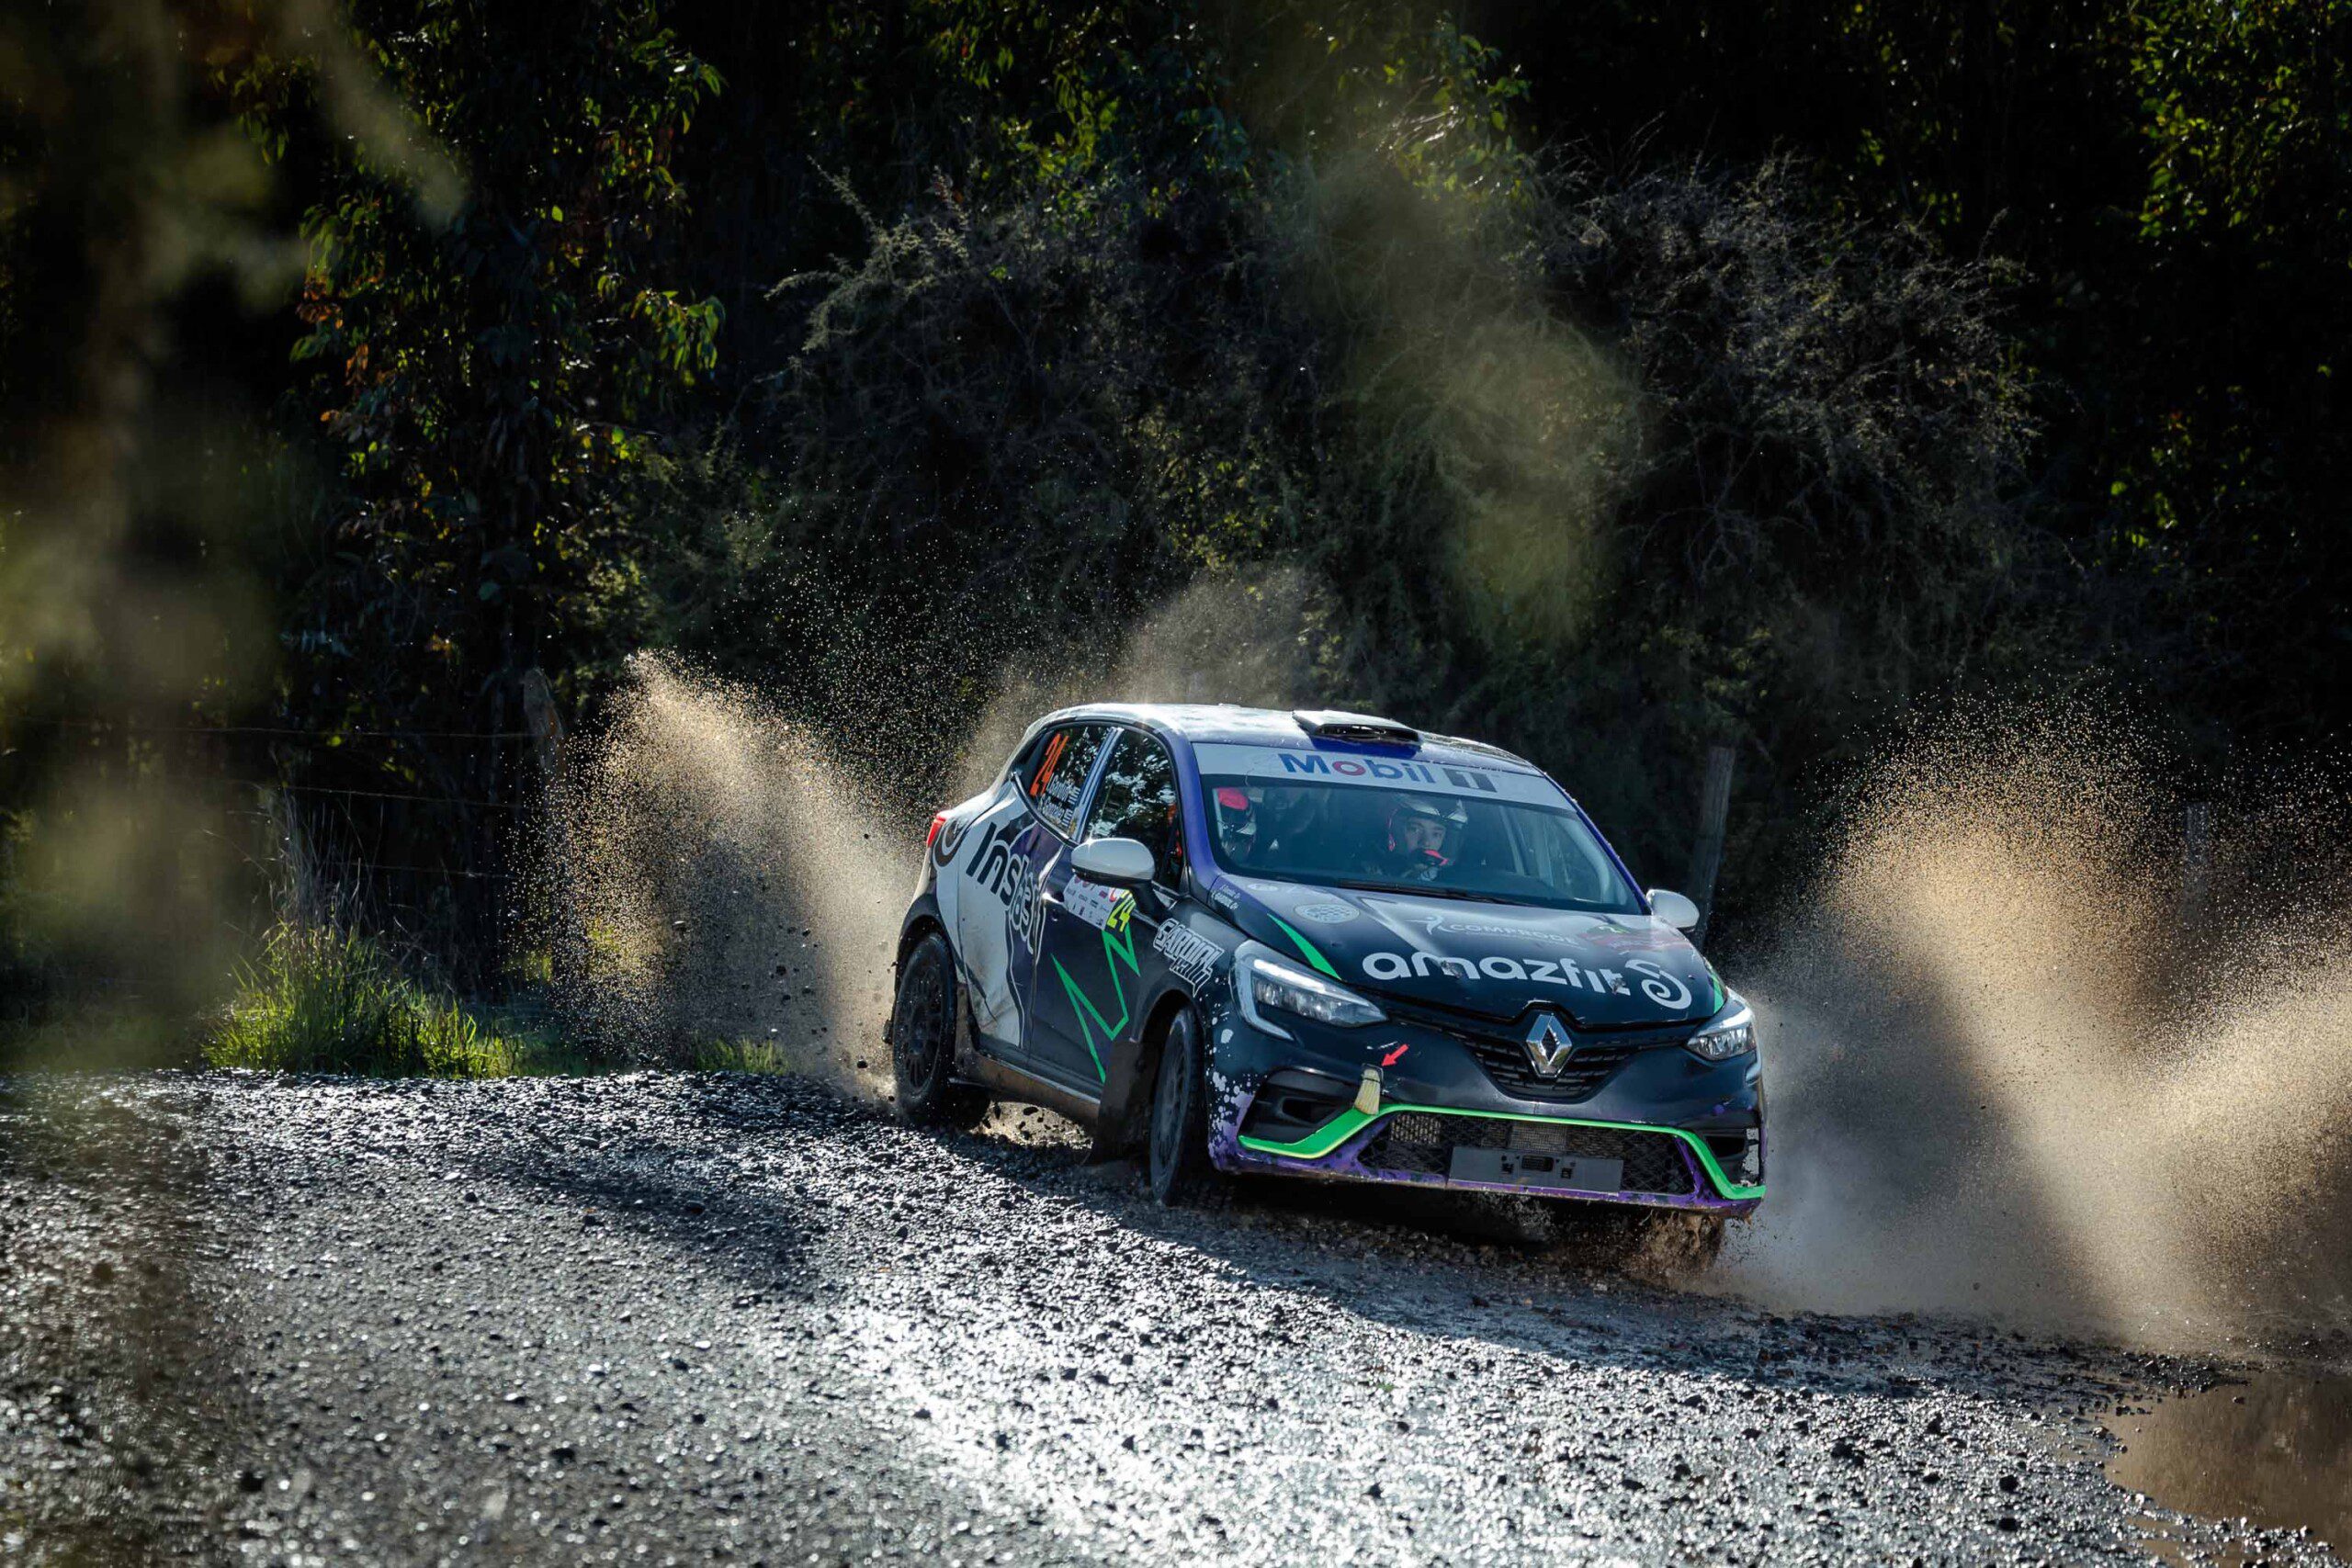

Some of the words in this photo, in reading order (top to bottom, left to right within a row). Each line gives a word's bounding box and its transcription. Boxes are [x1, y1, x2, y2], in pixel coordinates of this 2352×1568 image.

[1278, 753, 1436, 783] Mobil
[1106, 890, 1136, 931] 24
[1363, 952, 1631, 996] amazfit
